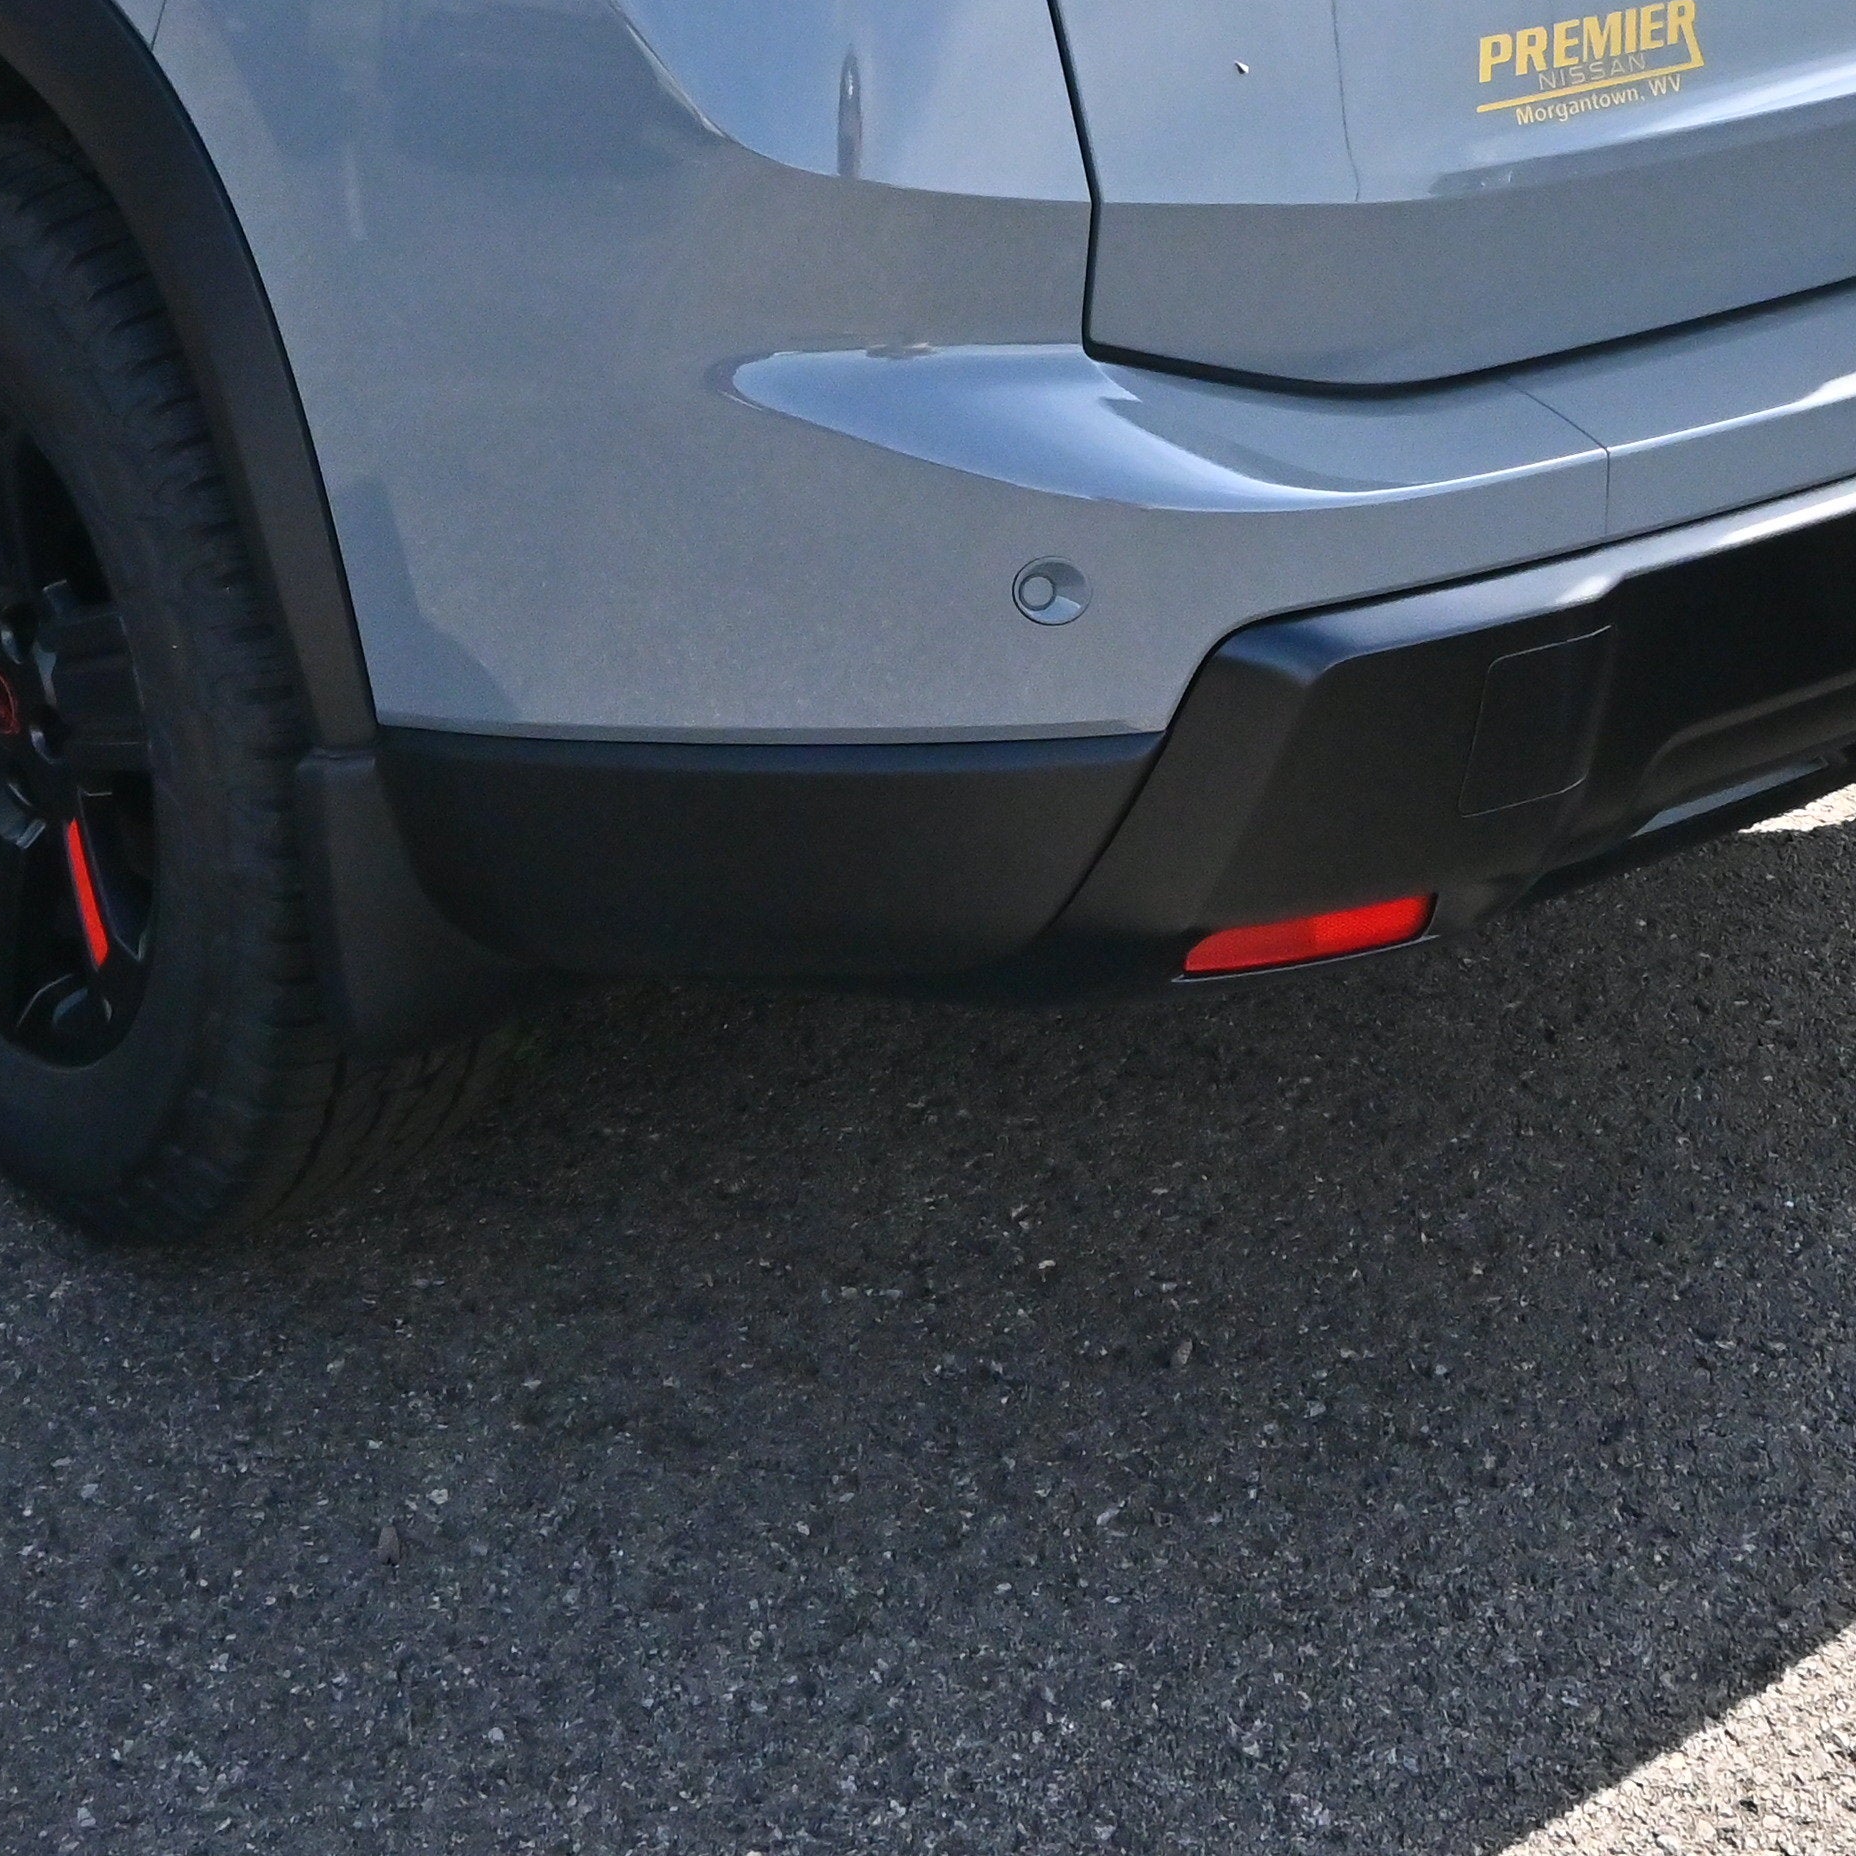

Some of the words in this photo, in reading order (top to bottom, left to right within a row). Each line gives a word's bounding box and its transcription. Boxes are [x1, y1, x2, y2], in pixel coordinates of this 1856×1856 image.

[1538, 53, 1646, 91] NISSAN
[1515, 87, 1646, 126] Morgantown,
[1648, 73, 1681, 97] WV
